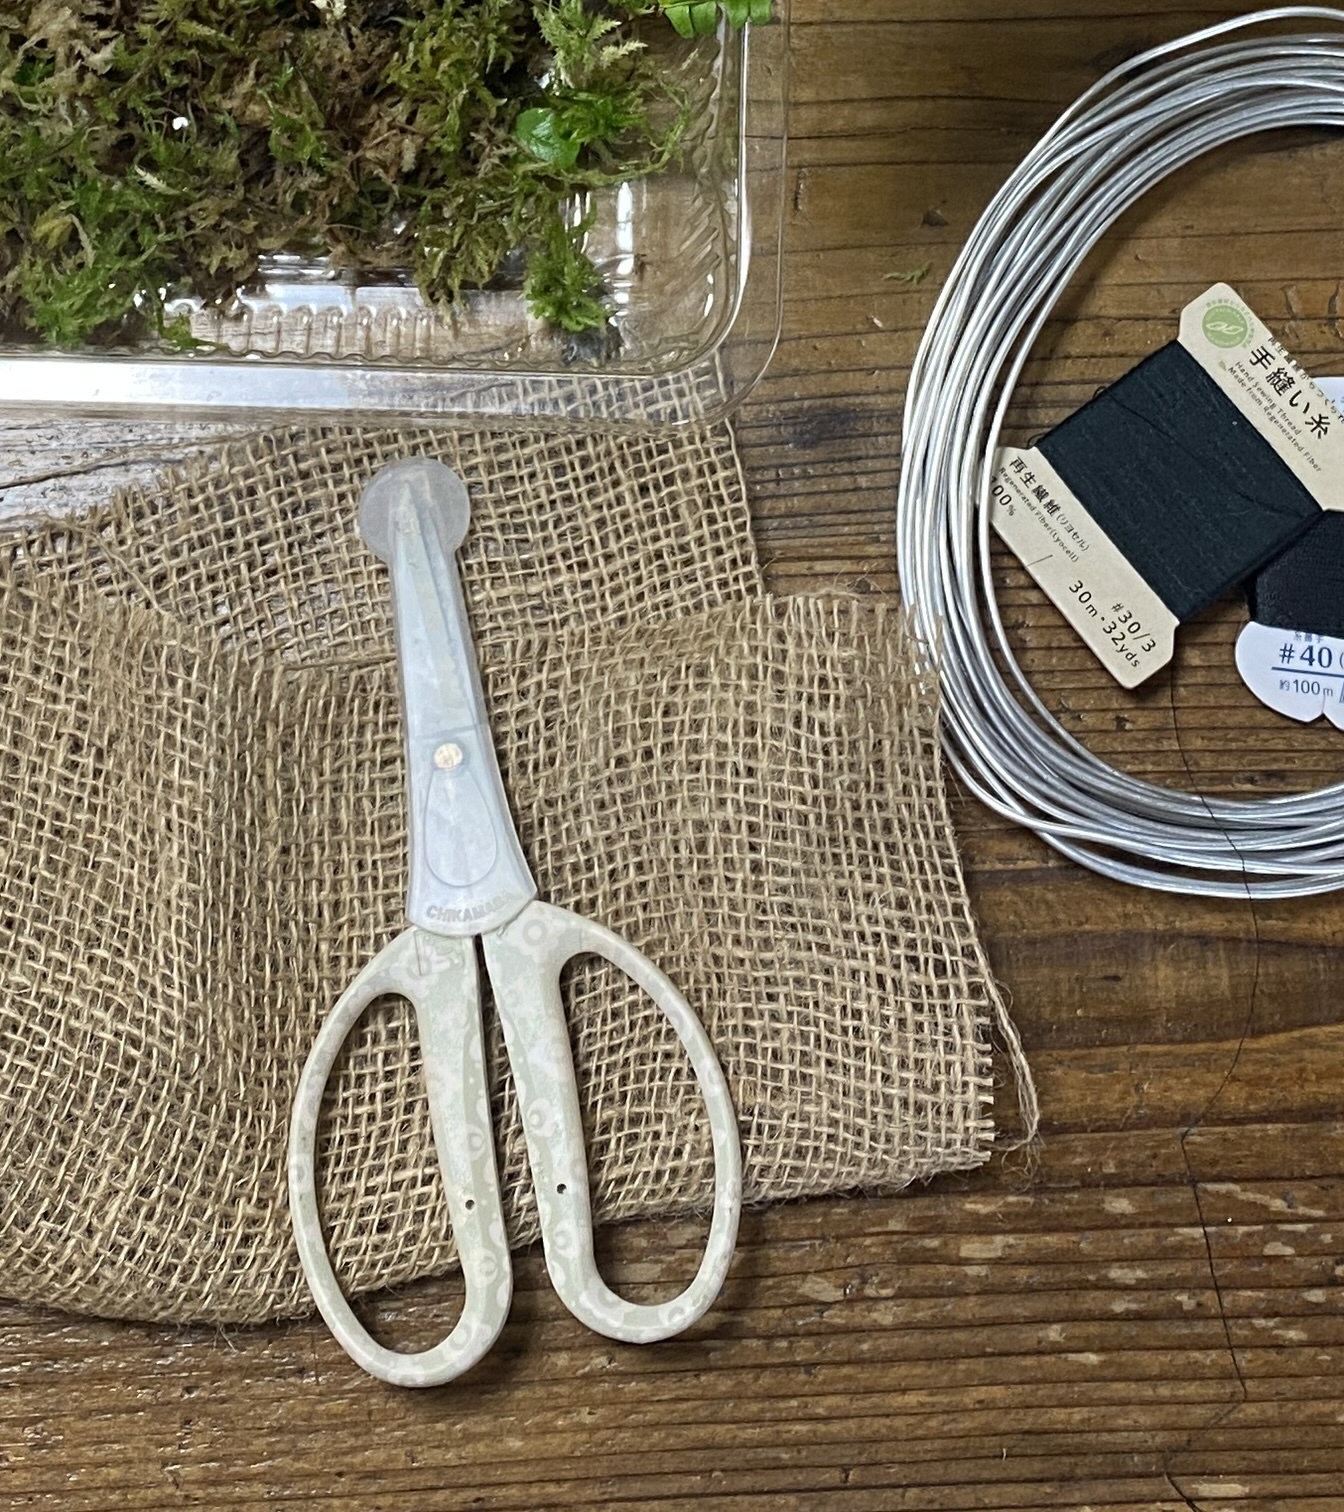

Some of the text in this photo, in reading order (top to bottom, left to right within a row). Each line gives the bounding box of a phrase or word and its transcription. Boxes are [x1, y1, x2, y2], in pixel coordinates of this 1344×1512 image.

[1228, 367, 1247, 389] Made
[1246, 387, 1263, 406] from
[1235, 361, 1254, 383] Hand
[1276, 408, 1302, 436] Thread
[1249, 346, 1330, 439] 手縫い糸
[1111, 602, 1157, 653] #30/3
[1278, 642, 1333, 669] #40
